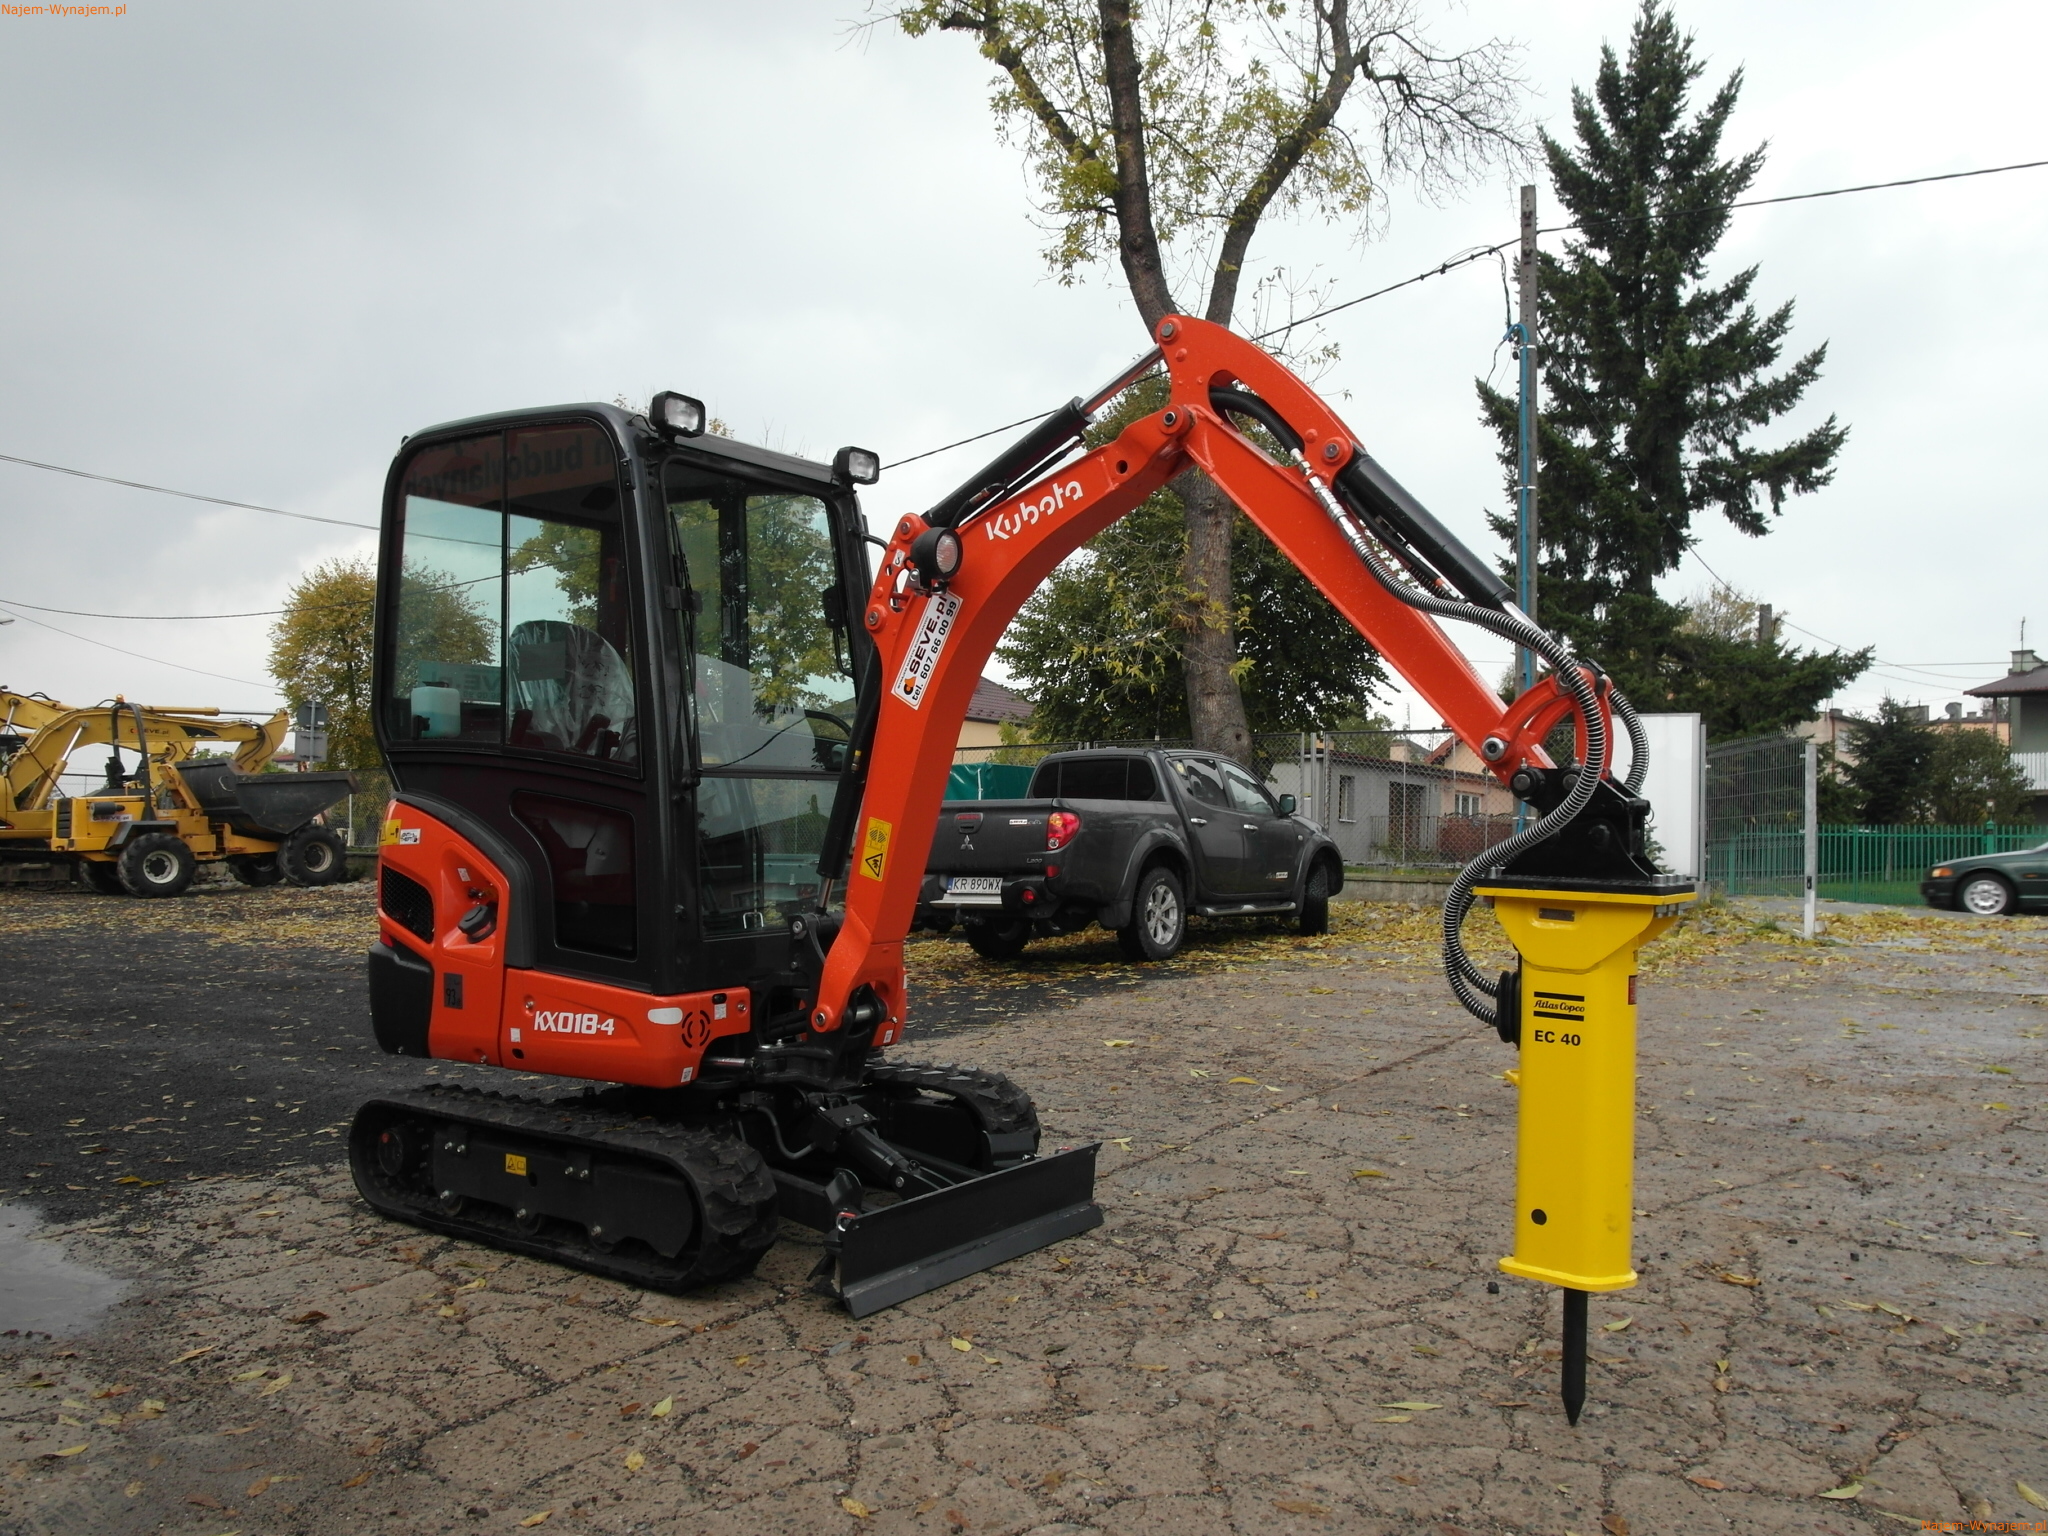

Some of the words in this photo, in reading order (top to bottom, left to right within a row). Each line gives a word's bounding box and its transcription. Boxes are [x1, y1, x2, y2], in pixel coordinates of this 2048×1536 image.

[985, 481, 1084, 540] Kubota
[909, 595, 948, 675] SEVE.pl
[912, 683, 923, 701] tel.
[920, 657, 933, 680] 607
[930, 637, 942, 654] 66
[938, 619, 949, 636] 00
[946, 601, 957, 618] 99
[144, 727, 169, 736] EVE.pl
[953, 878, 967, 890] KR
[970, 878, 1002, 890] 890WX
[1534, 999, 1559, 1010] Atlas
[1559, 1002, 1585, 1013] Copco
[534, 1010, 615, 1036] KX018-4
[1534, 1029, 1556, 1044] EC
[1560, 1033, 1581, 1047] 40
